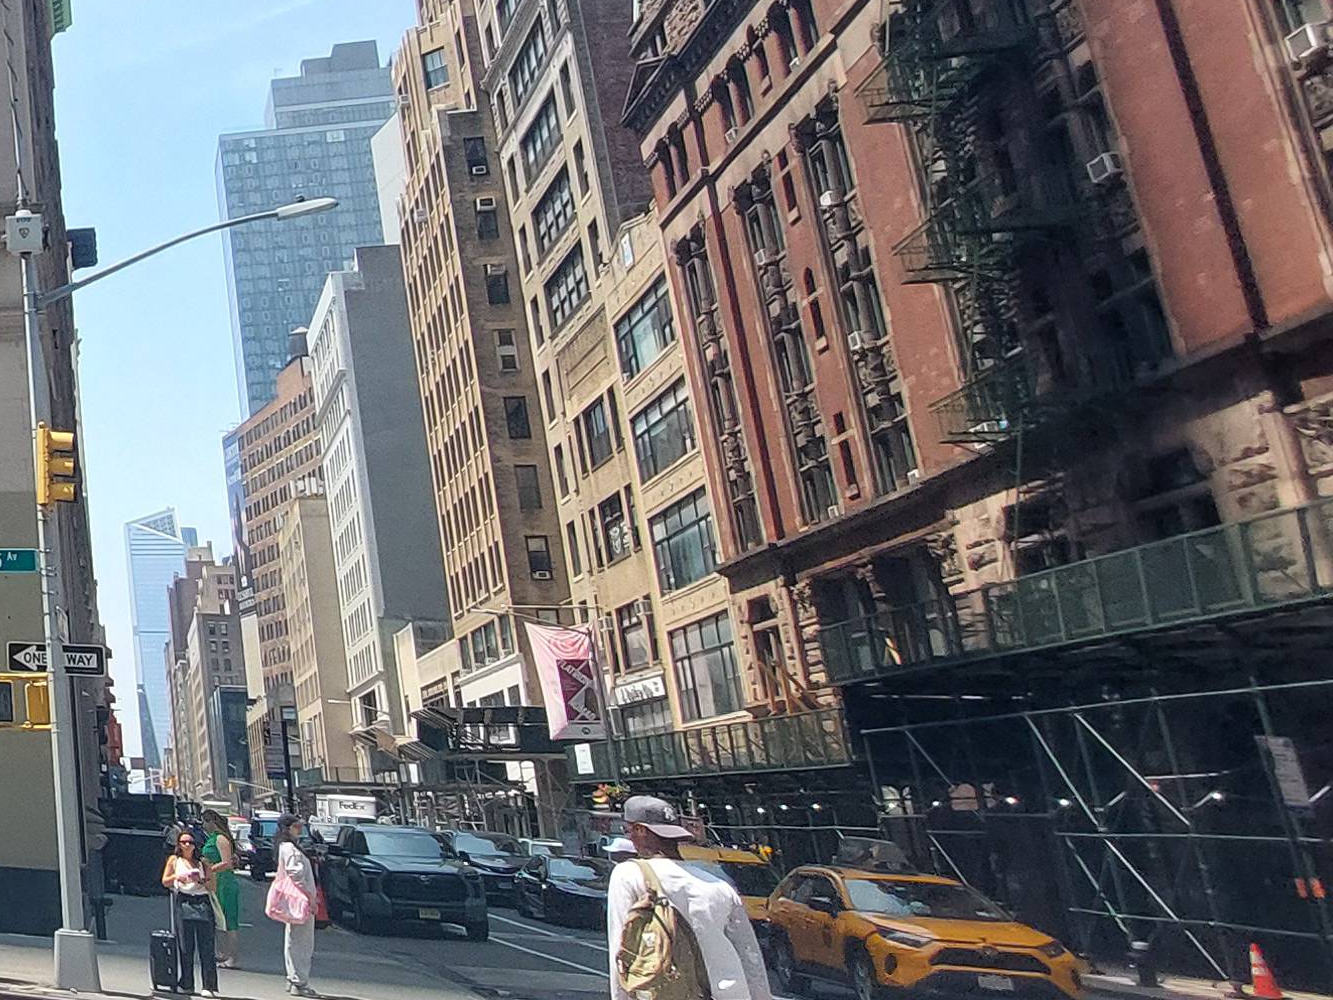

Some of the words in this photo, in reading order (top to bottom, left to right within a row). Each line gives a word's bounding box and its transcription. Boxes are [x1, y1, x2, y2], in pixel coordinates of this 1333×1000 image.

[6, 552, 18, 561] Av
[23, 652, 47, 664] ONE
[66, 654, 93, 667] WAY
[339, 801, 365, 810] FedEx
